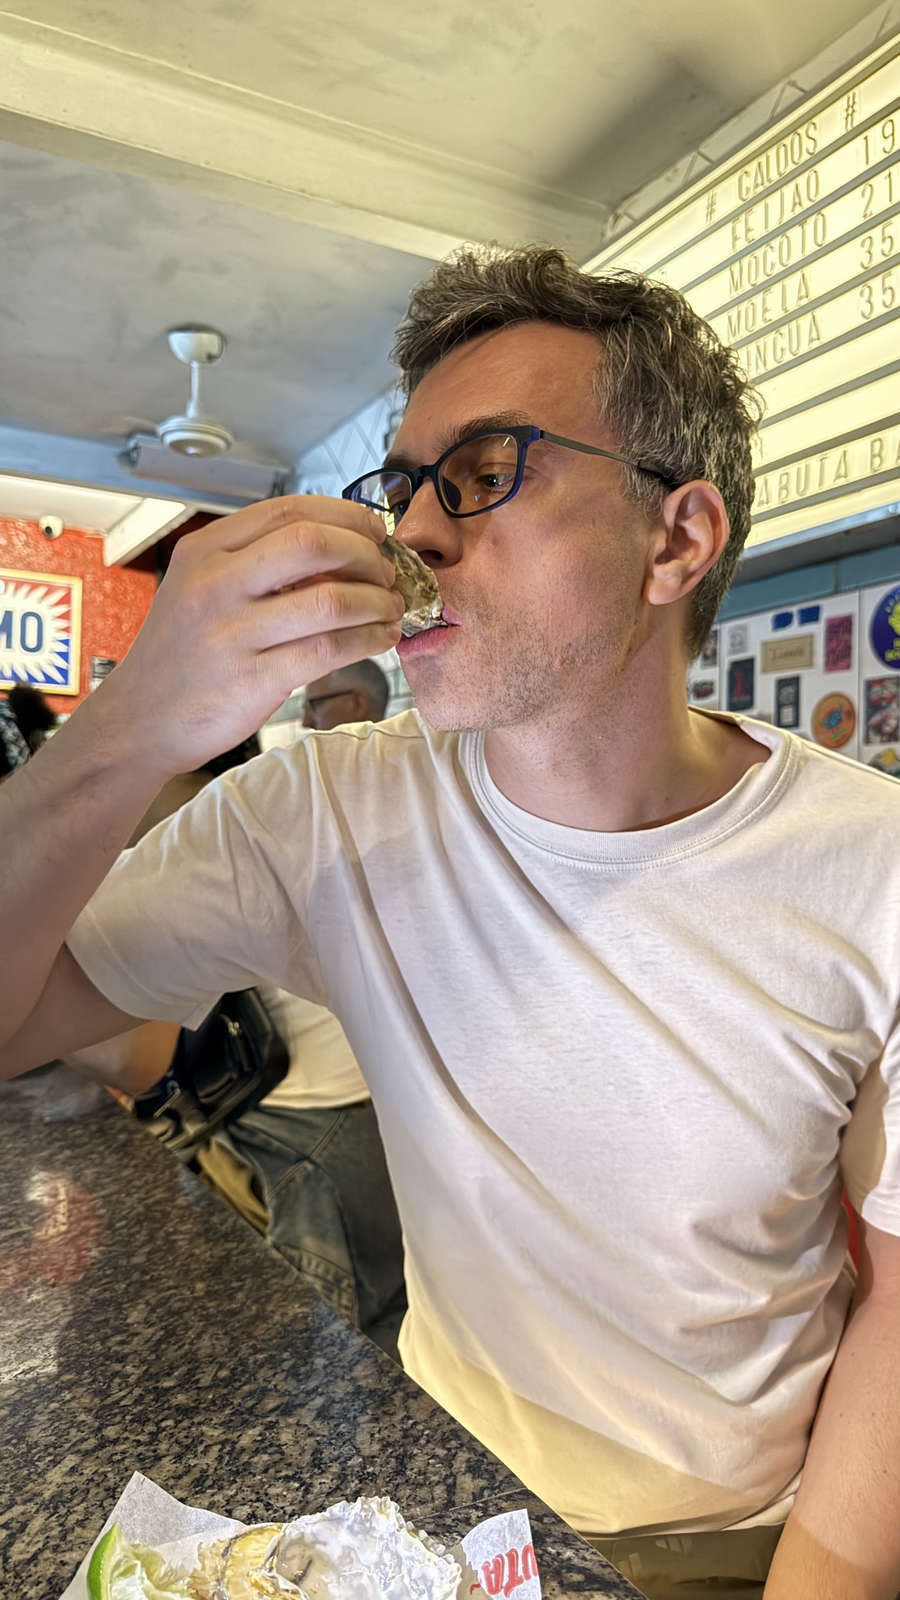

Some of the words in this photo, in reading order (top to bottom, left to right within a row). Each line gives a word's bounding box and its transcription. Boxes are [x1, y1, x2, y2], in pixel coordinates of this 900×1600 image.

[731, 168, 820, 250] FEIJAO
[863, 119, 895, 165] 19
[738, 121, 818, 202] CALDOS
[727, 269, 809, 343] MOELA
[860, 220, 894, 270] 35
[729, 211, 827, 296] MOCOTO
[861, 169, 893, 219] 21
[746, 311, 820, 375] INGUA
[859, 271, 895, 319] 35
[757, 449, 848, 505] ABUTA
